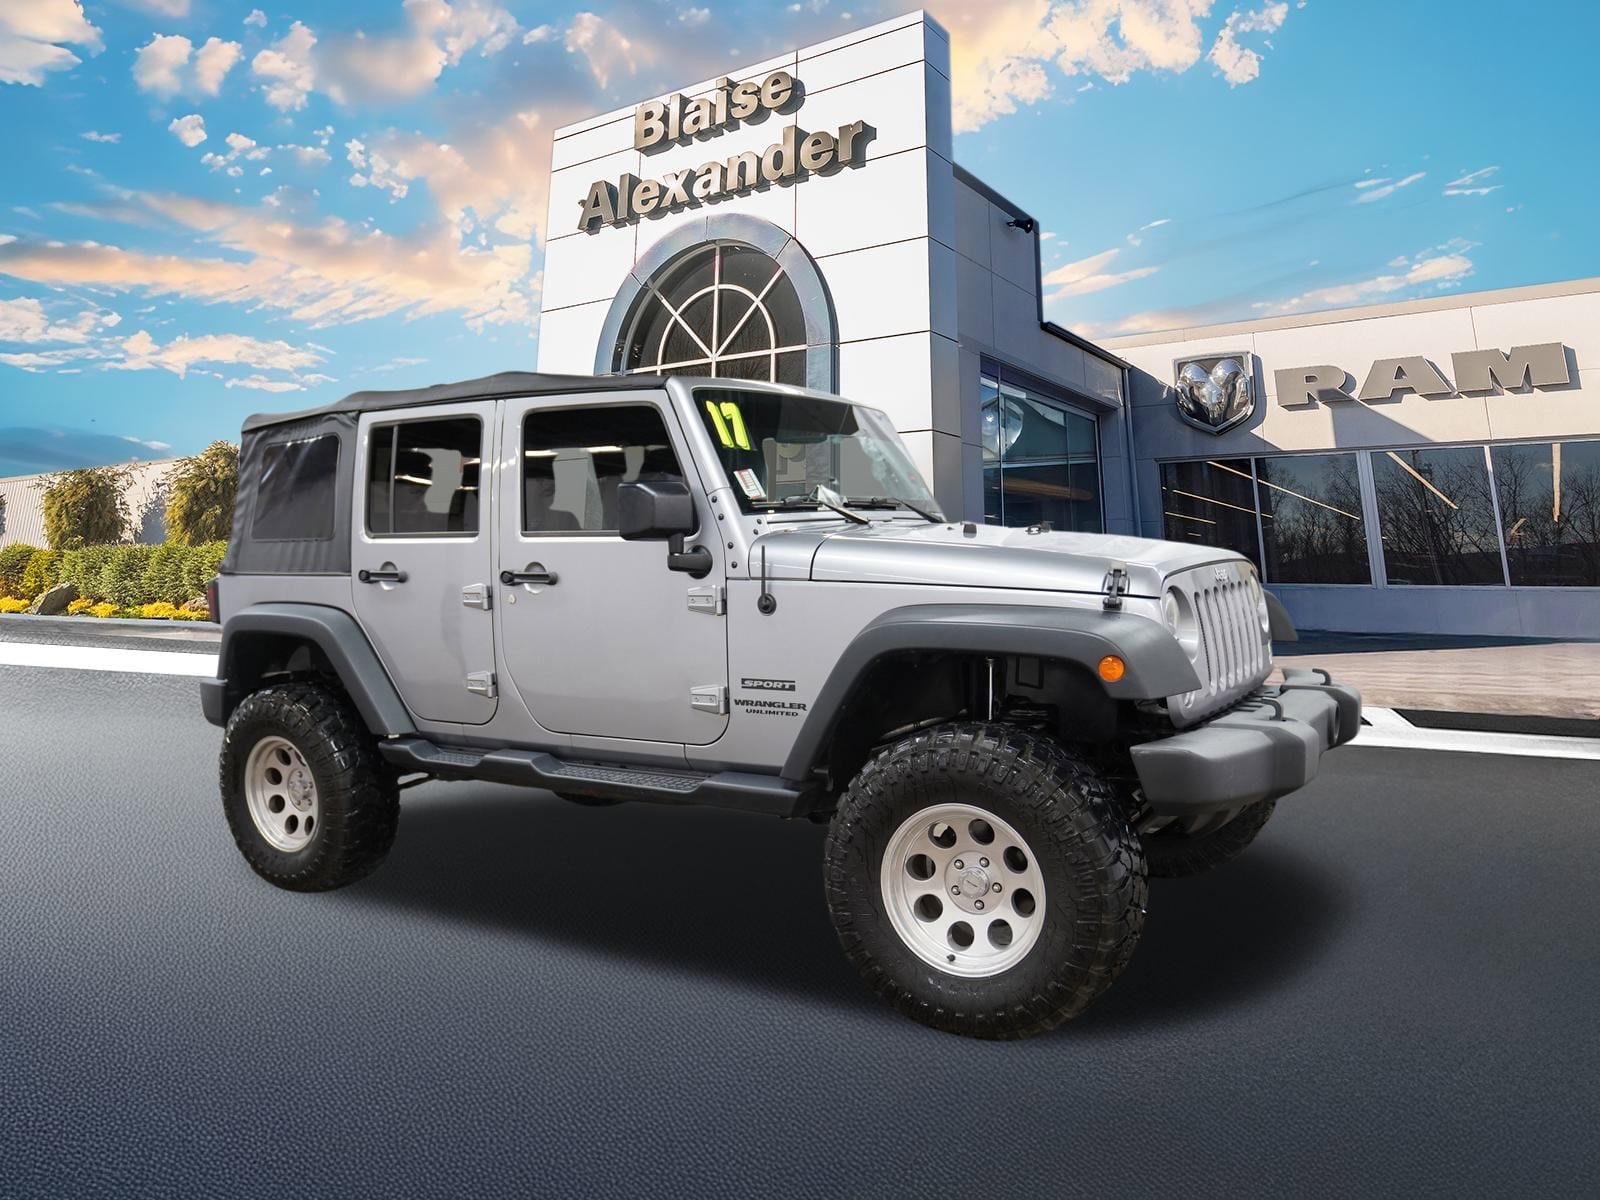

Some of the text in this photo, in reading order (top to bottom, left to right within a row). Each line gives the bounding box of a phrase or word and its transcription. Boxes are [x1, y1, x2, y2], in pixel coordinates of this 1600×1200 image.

[634, 71, 803, 156] Blaise
[578, 120, 876, 233] Alexander
[1274, 342, 1576, 409] RAM
[706, 401, 750, 450] 17
[734, 699, 807, 711] WRANGLER
[741, 678, 795, 691] SPORT
[746, 708, 799, 717] UNLIMITED
